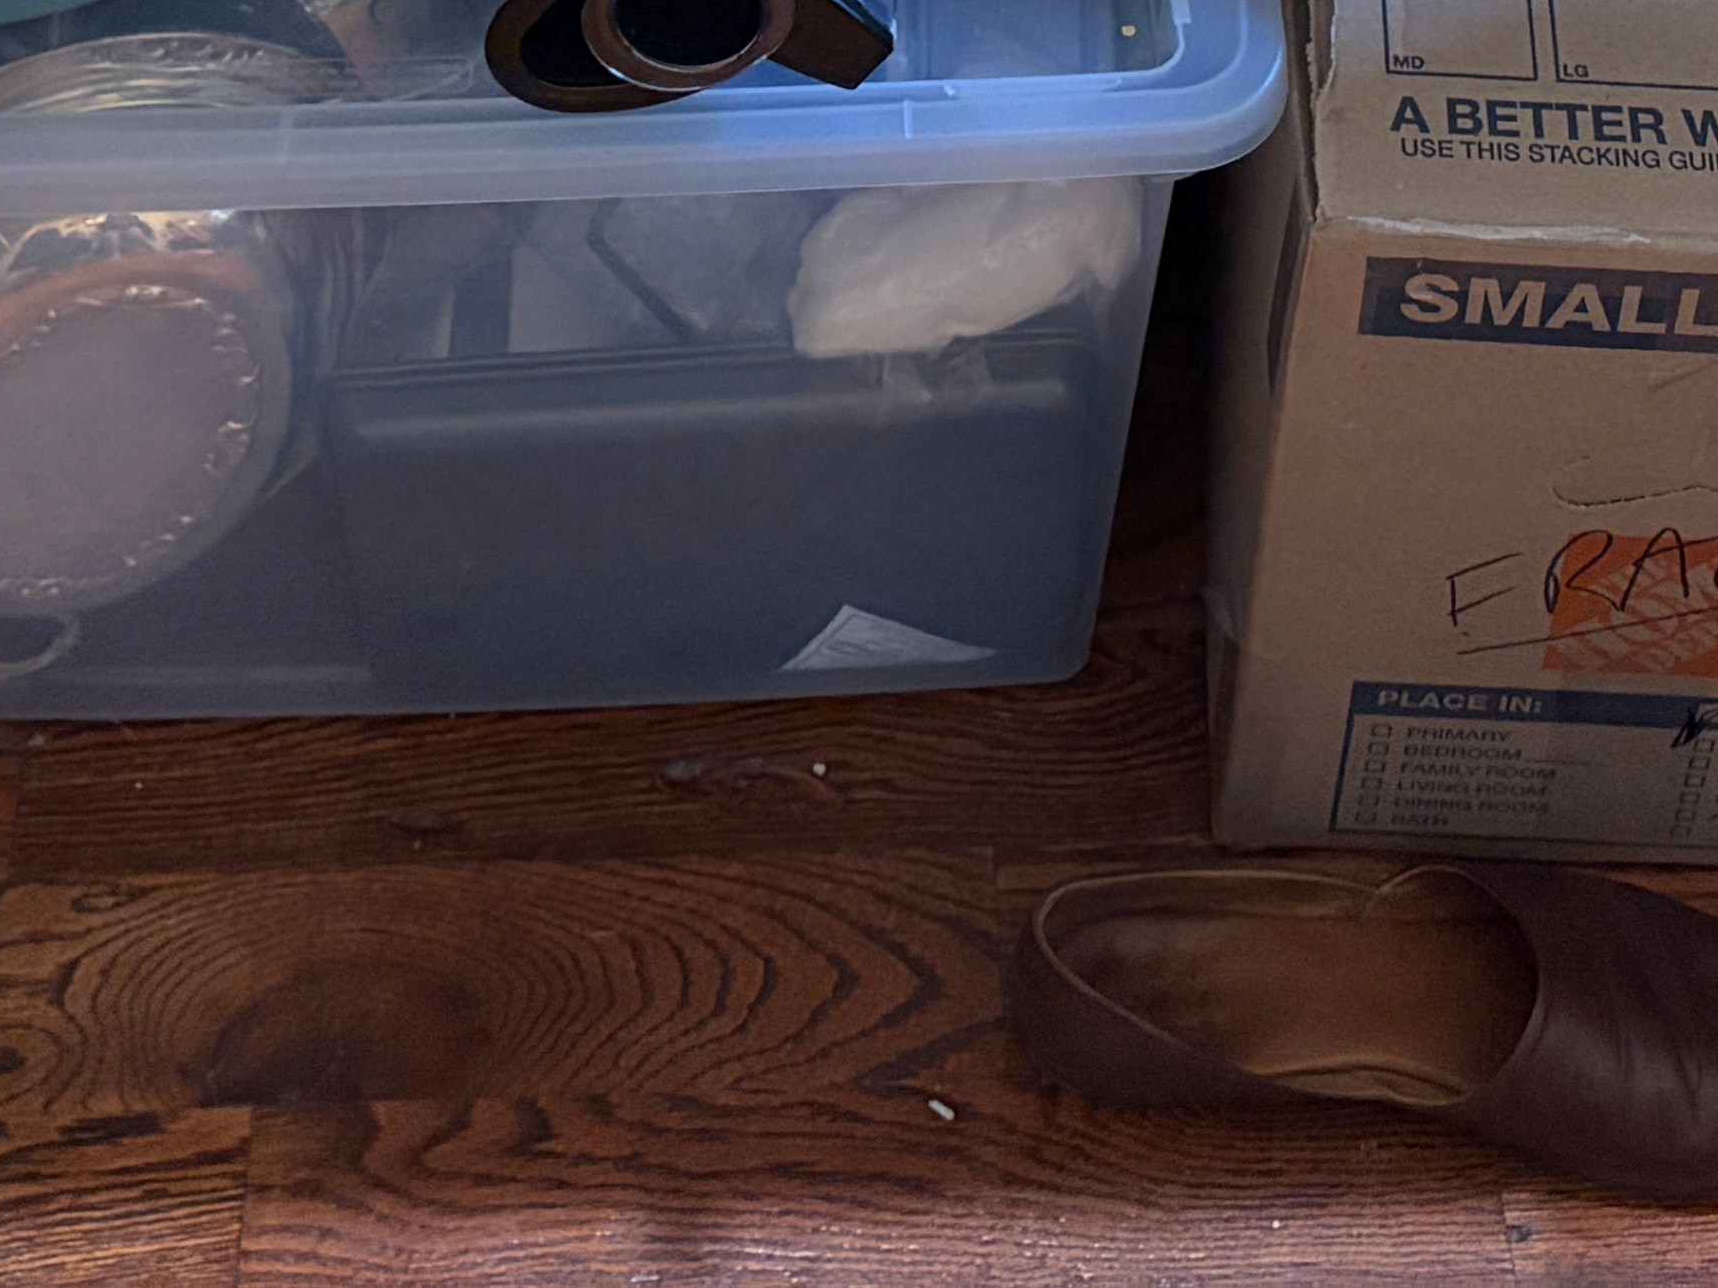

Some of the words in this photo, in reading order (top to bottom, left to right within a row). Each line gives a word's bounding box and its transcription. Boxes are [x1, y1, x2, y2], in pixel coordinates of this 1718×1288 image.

[1392, 55, 1425, 71] MD
[1562, 64, 1589, 78] LG
[1390, 96, 1430, 133] A
[1446, 97, 1667, 145] BETTER
[1400, 138, 1454, 158] USE
[1459, 140, 1521, 162] THIS
[1528, 143, 1661, 169] STACKING
[1378, 689, 1487, 712] PLACE
[1498, 693, 1542, 714] IN:
[1406, 727, 1511, 742] PRIMARY
[1403, 744, 1522, 759] BEDROOM
[1401, 761, 1478, 777] FAMILY
[1484, 765, 1556, 780] ROOM
[1397, 779, 1470, 795] LIVING
[1475, 783, 1548, 797] ROOM
[1477, 800, 1549, 815] ROOM
